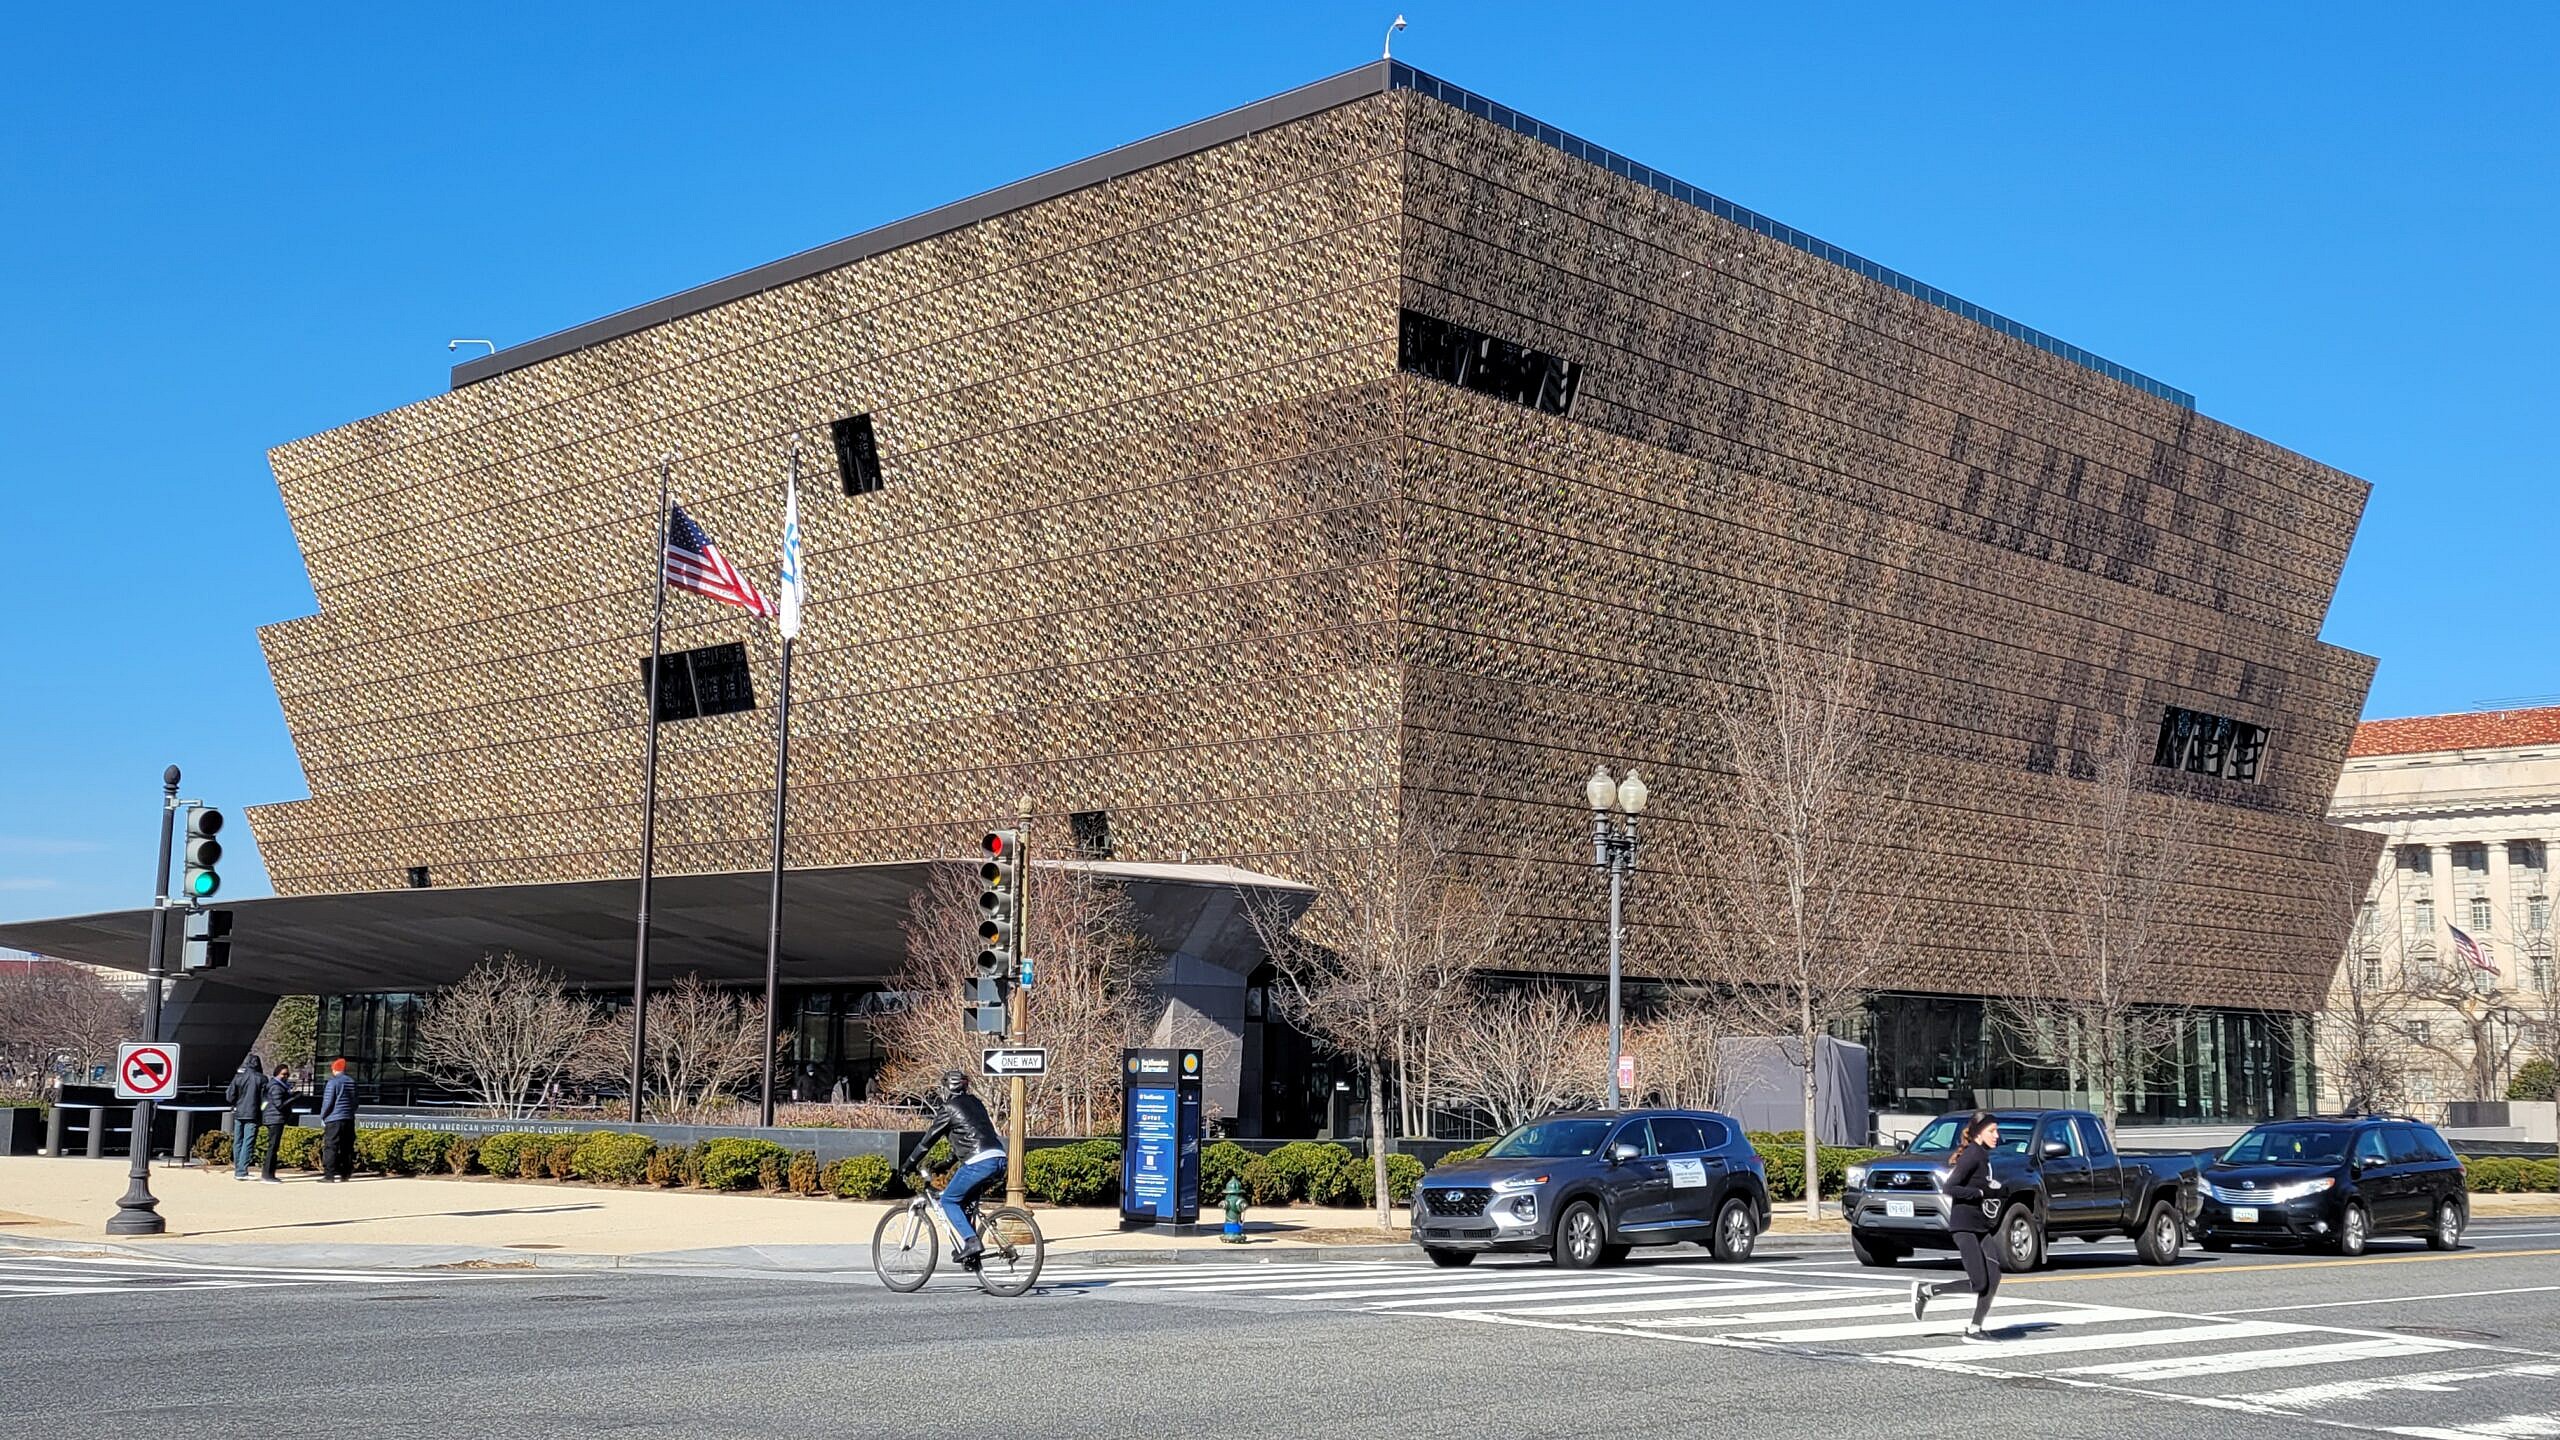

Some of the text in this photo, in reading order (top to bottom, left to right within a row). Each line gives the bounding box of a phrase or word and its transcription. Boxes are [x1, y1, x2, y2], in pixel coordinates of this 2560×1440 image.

[1002, 1057, 1038, 1067] ONE WAY
[360, 1121, 390, 1129] MUSEUM
[406, 1122, 437, 1130] AFRICAN
[440, 1123, 479, 1131] AMERICAN
[481, 1124, 514, 1132] HISTORY
[518, 1125, 535, 1133] AND
[538, 1126, 575, 1134] CULTURE
